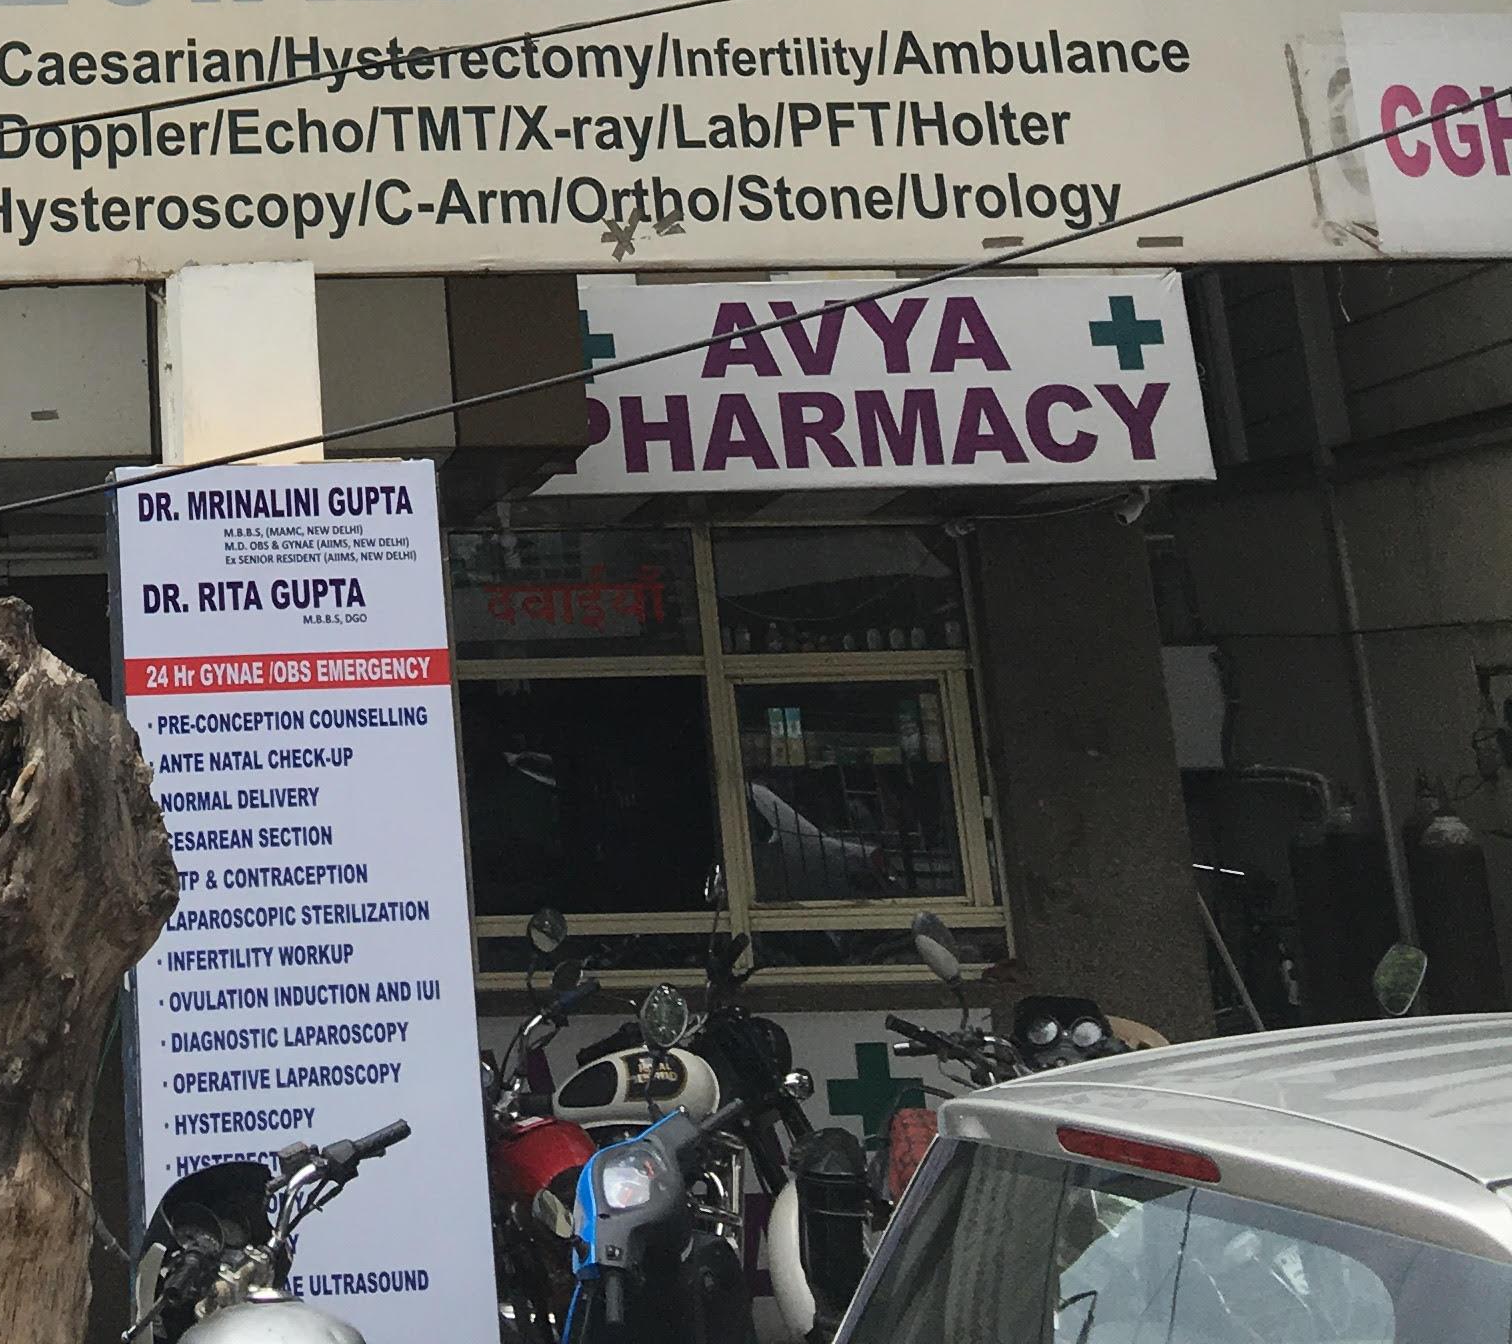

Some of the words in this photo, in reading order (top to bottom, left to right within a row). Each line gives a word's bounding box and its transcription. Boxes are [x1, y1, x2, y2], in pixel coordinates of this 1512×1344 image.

[700, 295, 1012, 379] AVYA
[138, 492, 179, 522] DR.
[188, 487, 319, 520] MRINALINI
[328, 485, 413, 516] GUPTA
[224, 542, 247, 551] M.D.
[250, 541, 269, 550] OBS
[272, 540, 279, 550] &
[282, 540, 314, 550] GYNAE
[317, 539, 351, 551] (AIIMS,
[353, 538, 376, 547] NEW
[379, 537, 409, 548] DELHI)
[307, 526, 330, 536] NEW
[332, 525, 363, 536] DELHI)
[225, 556, 237, 565] Ex
[239, 555, 274, 564] SENIOR
[277, 554, 321, 563] RESIDENT
[324, 552, 358, 564] (AIIMS,
[361, 552, 383, 561] NEW
[386, 551, 417, 562] DELHI)
[143, 583, 189, 614] DR.
[199, 580, 263, 612] RITA
[270, 577, 366, 611] GUPTA
[345, 613, 367, 623] DGO
[146, 665, 169, 688] 24
[174, 663, 195, 687] Hr
[200, 660, 264, 686] GYNAE
[316, 656, 430, 682] EMERGENCY
[157, 709, 305, 735] PRE-CONCEPTION
[309, 706, 428, 730] COUNSELLING
[159, 752, 204, 773] ANTE
[209, 749, 263, 772] NATAL
[268, 746, 353, 770] CHECK-UP
[161, 791, 233, 813] NORMAL
[237, 787, 320, 811] DELIVERY
[258, 825, 333, 848] SECTION
[178, 870, 200, 891] TP
[205, 869, 218, 890] &
[223, 863, 368, 890] CONTRACEPTION
[166, 905, 297, 932] LAPAROSCOPIC
[301, 900, 430, 926] STERILIZATION
[167, 947, 273, 972] INFERTILITY
[278, 943, 354, 967] WORKUP
[169, 987, 269, 1012] OVULATION
[274, 983, 371, 1009] INDUCTION
[375, 980, 412, 1003] AND
[417, 979, 441, 1001] IUI
[171, 1027, 278, 1053] DIAGNOSTIC
[284, 1022, 409, 1048] LAPAROSCOPY
[172, 1068, 271, 1094] OPERATIVE
[275, 1063, 402, 1089] LAPAROSCOPY
[175, 1108, 315, 1135] HYSTEROSCOPY
[309, 1269, 429, 1296] ULTRASOUND
